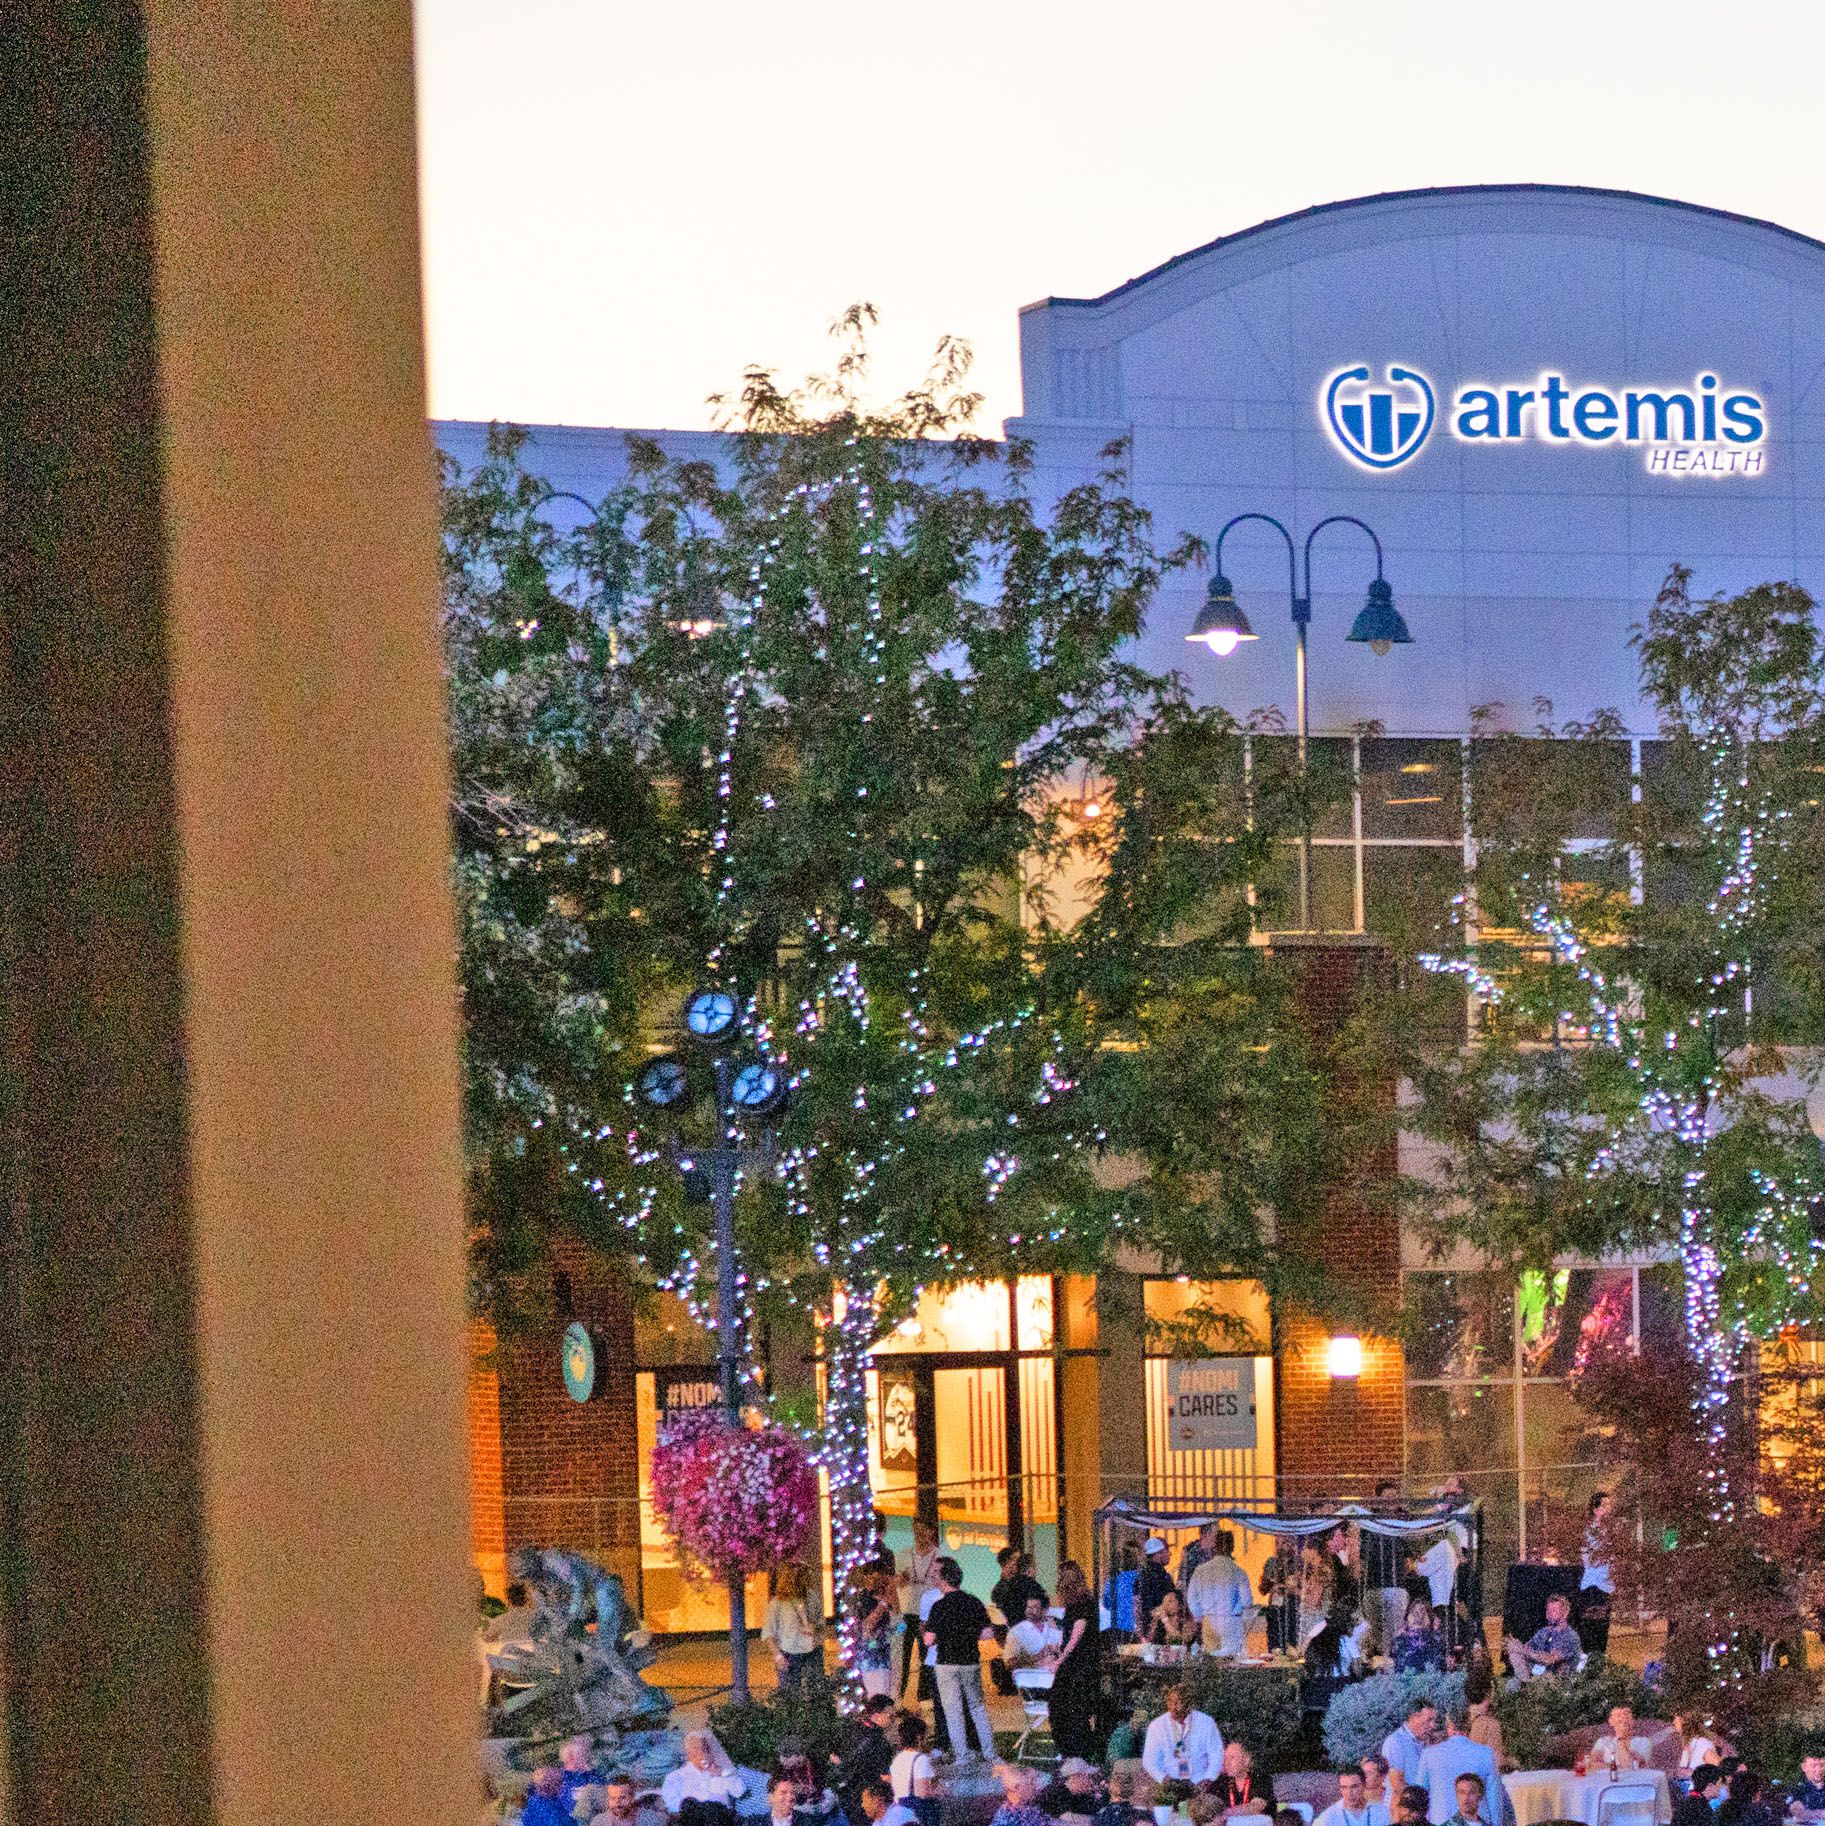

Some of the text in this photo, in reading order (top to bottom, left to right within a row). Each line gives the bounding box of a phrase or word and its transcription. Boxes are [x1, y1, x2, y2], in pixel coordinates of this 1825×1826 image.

[1456, 372, 1764, 444] artemis
[1649, 449, 1763, 472] HEALTH
[666, 1382, 722, 1408] #NOM
[1179, 1393, 1238, 1418] CARES
